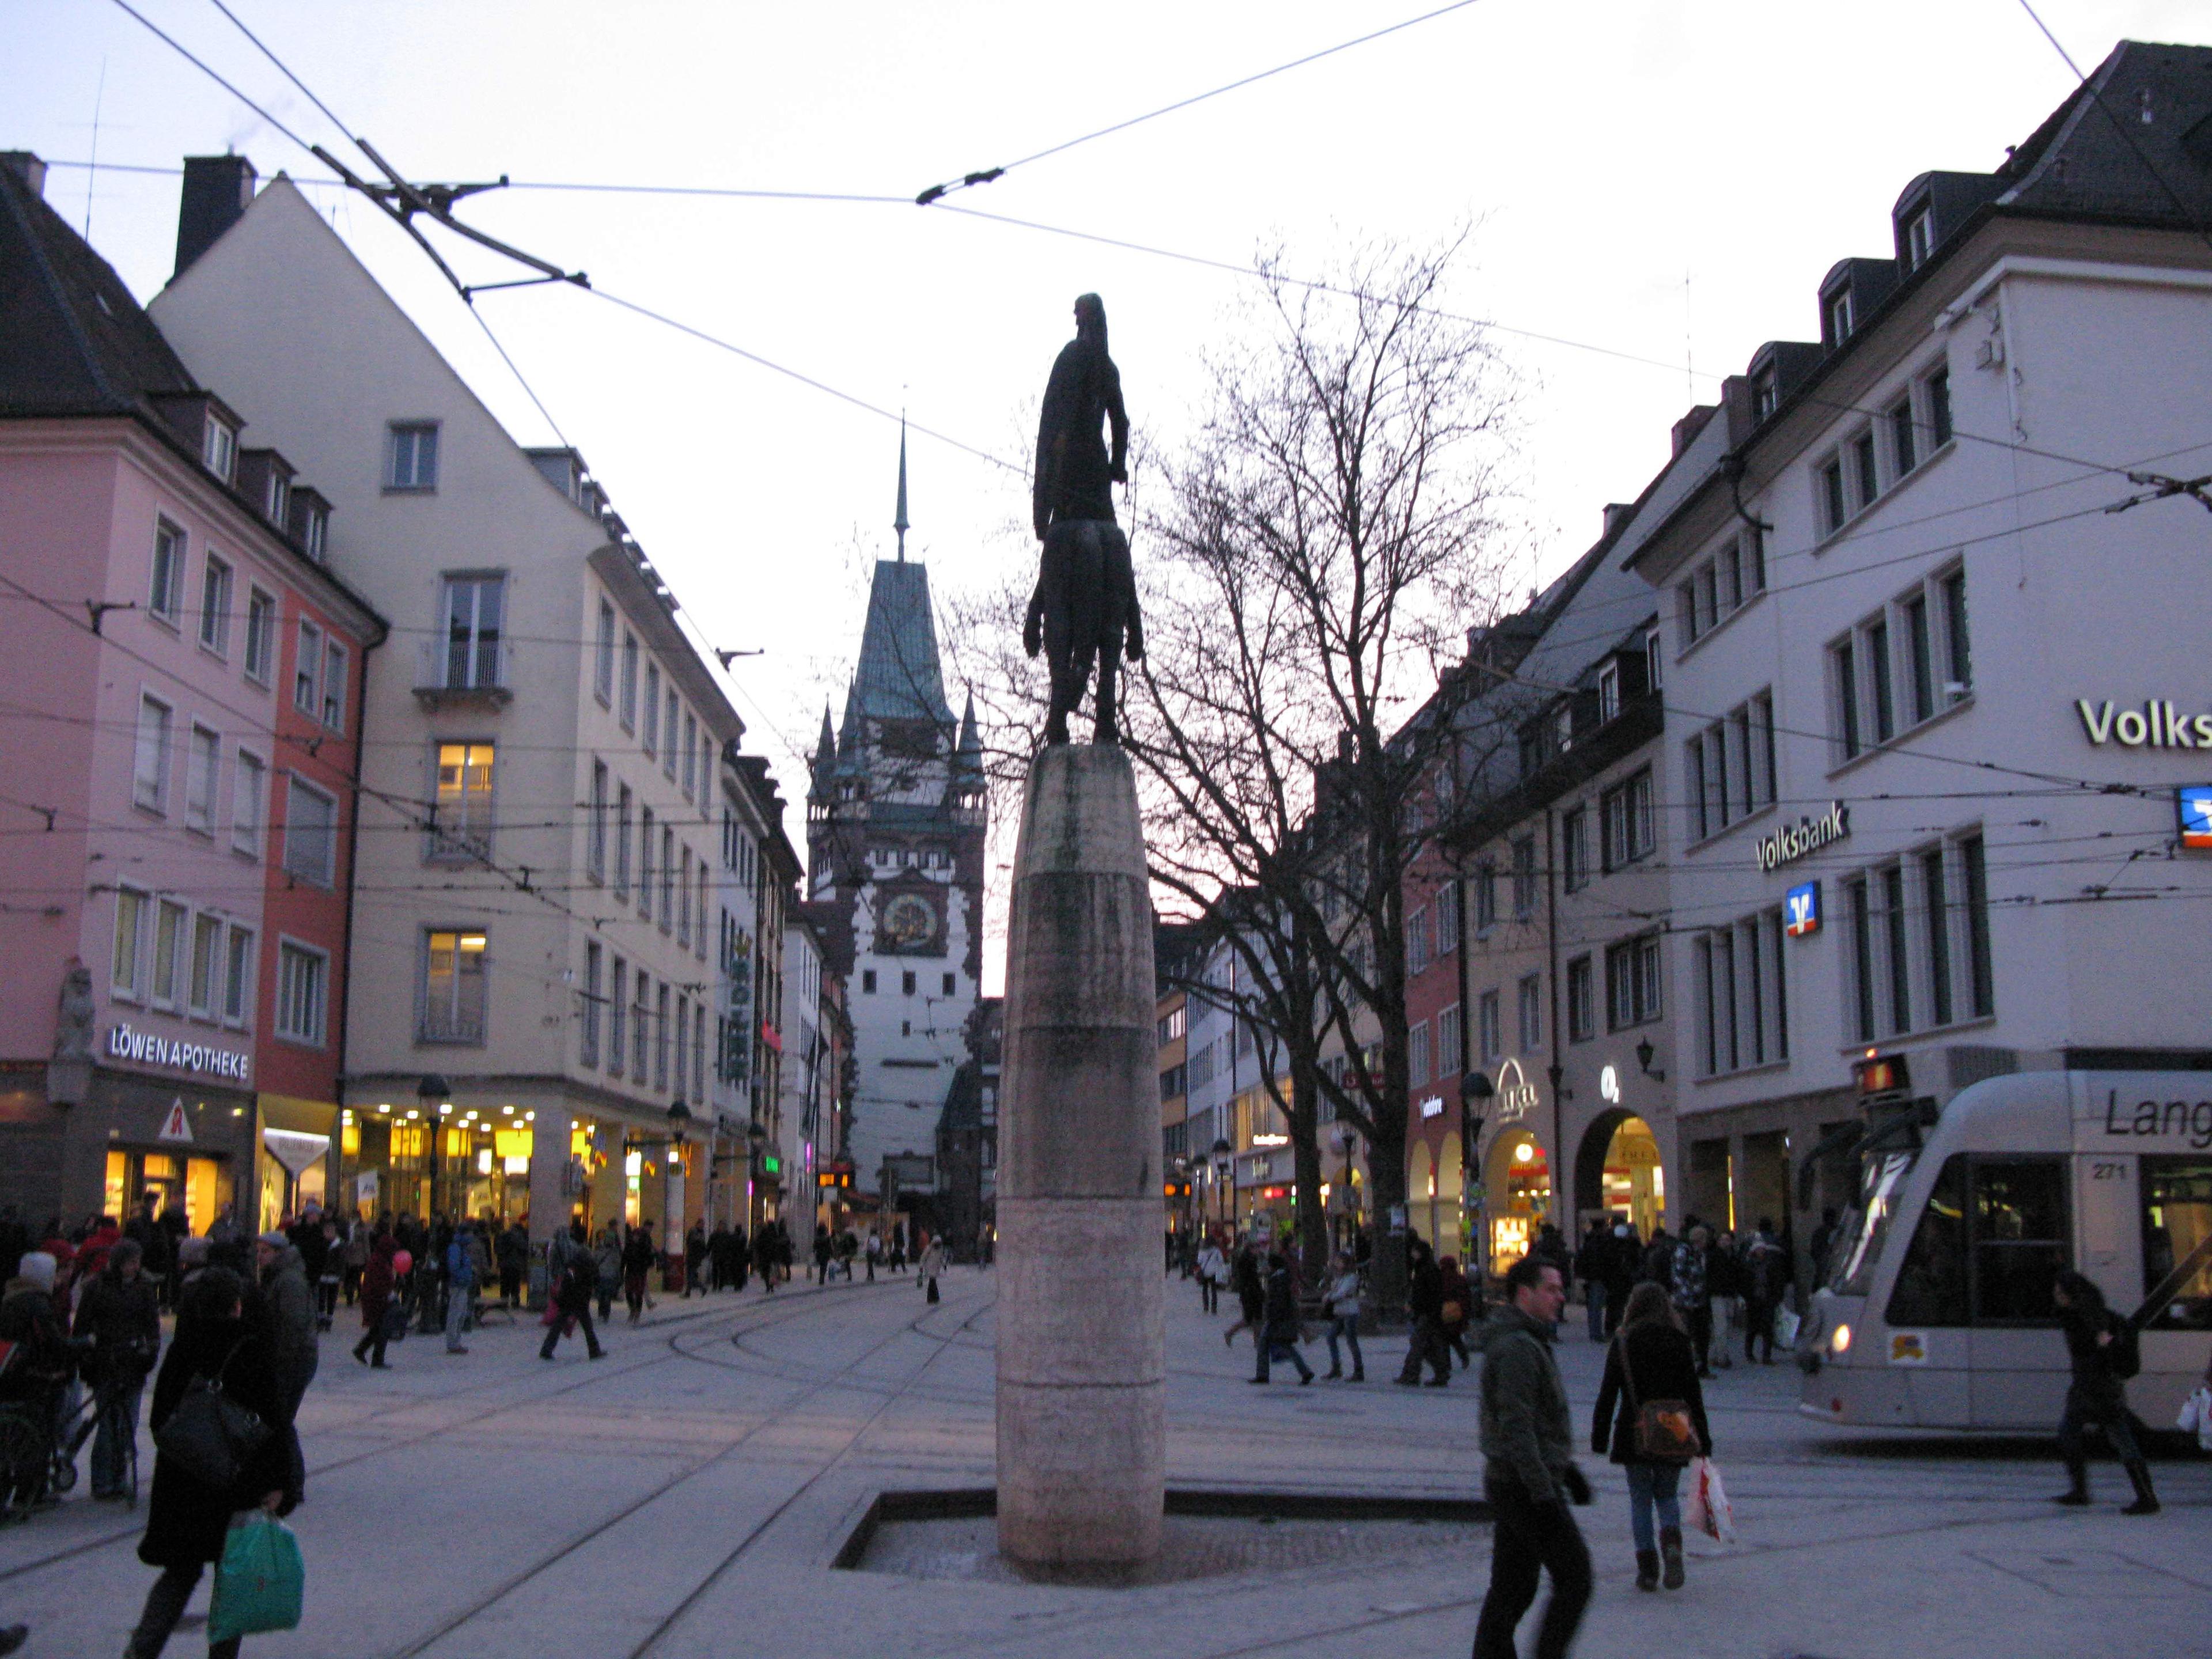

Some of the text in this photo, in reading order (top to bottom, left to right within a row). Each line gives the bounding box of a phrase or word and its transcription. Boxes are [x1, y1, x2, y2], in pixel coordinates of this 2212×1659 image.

[2077, 699, 2212, 748] Volks
[1756, 801, 1844, 871] Volksbank
[112, 1023, 248, 1079] LÖWEN APOTHEKE
[2106, 1088, 2212, 1149] Lang
[2093, 1162, 2125, 1180] 271
